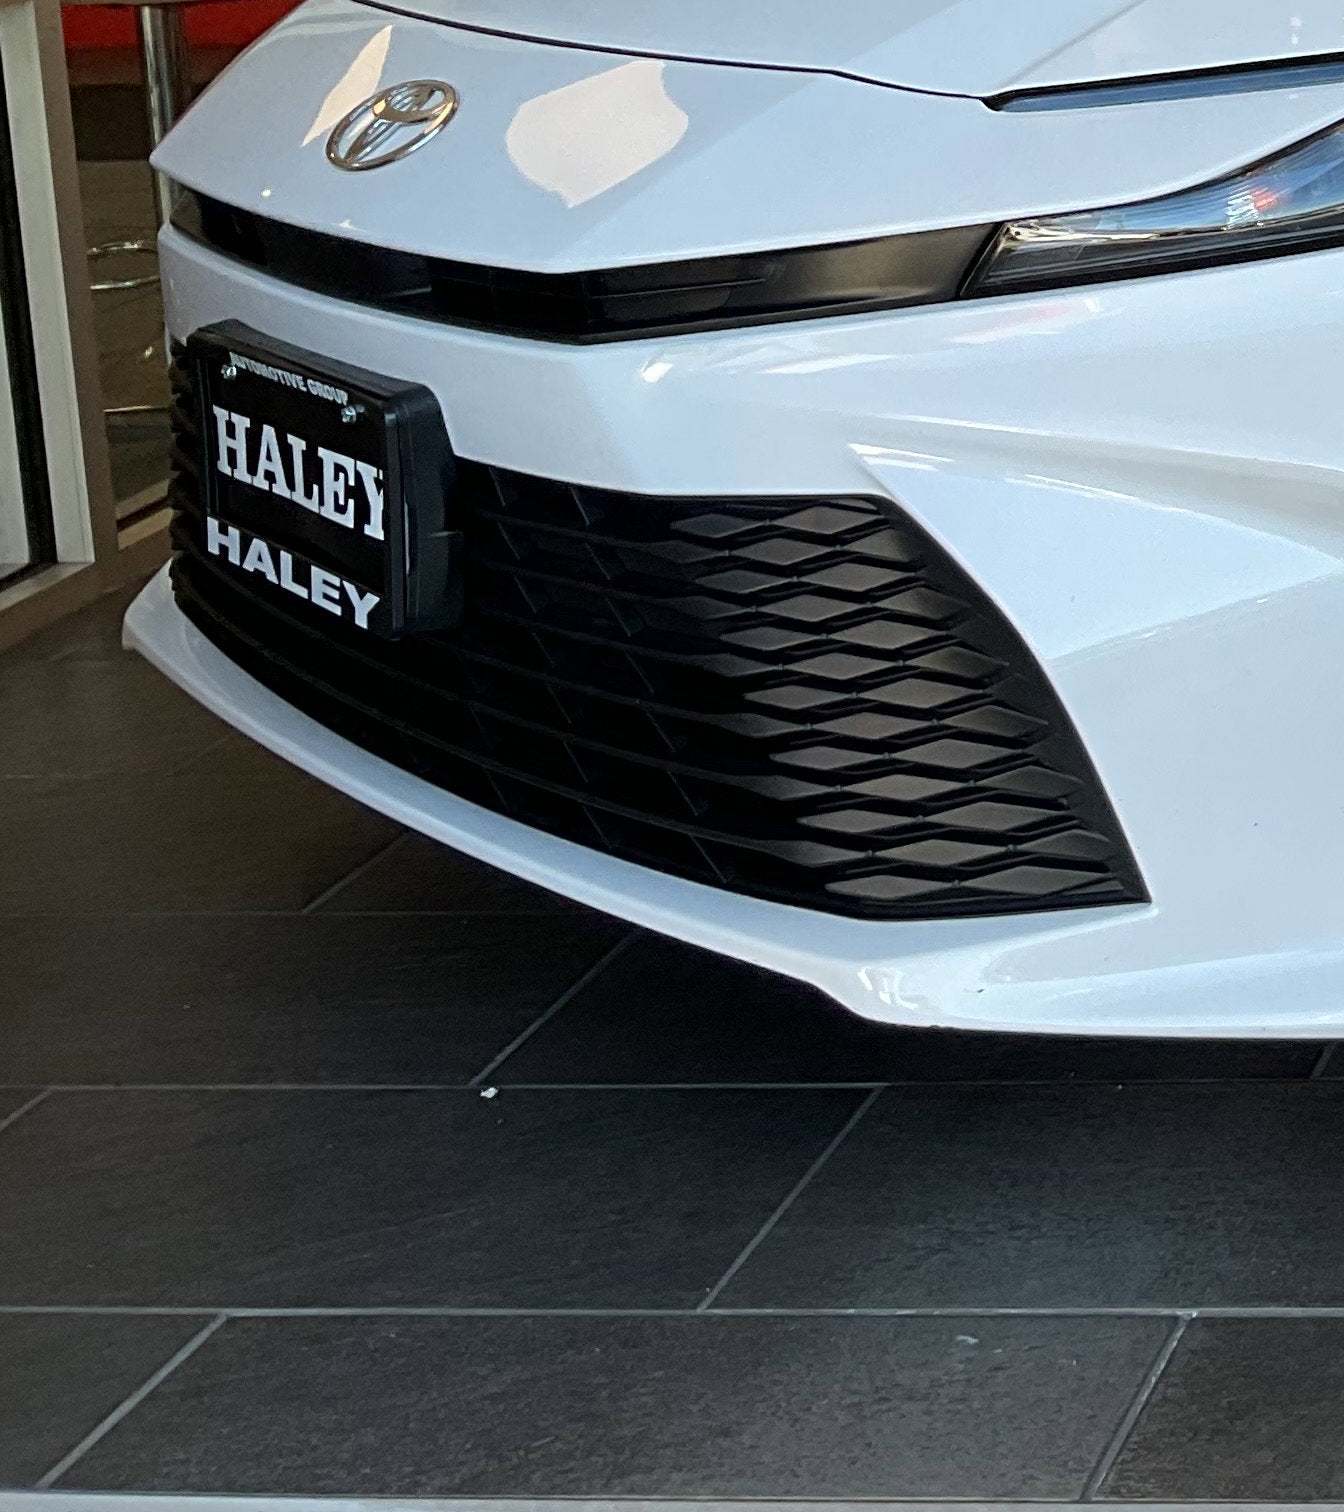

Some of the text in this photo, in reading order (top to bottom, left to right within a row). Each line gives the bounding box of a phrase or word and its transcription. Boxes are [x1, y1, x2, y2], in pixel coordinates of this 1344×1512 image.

[229, 351, 349, 407] AUTOMOTIVE GROUP
[212, 404, 385, 541] HALEY
[206, 515, 381, 630] HALEY
